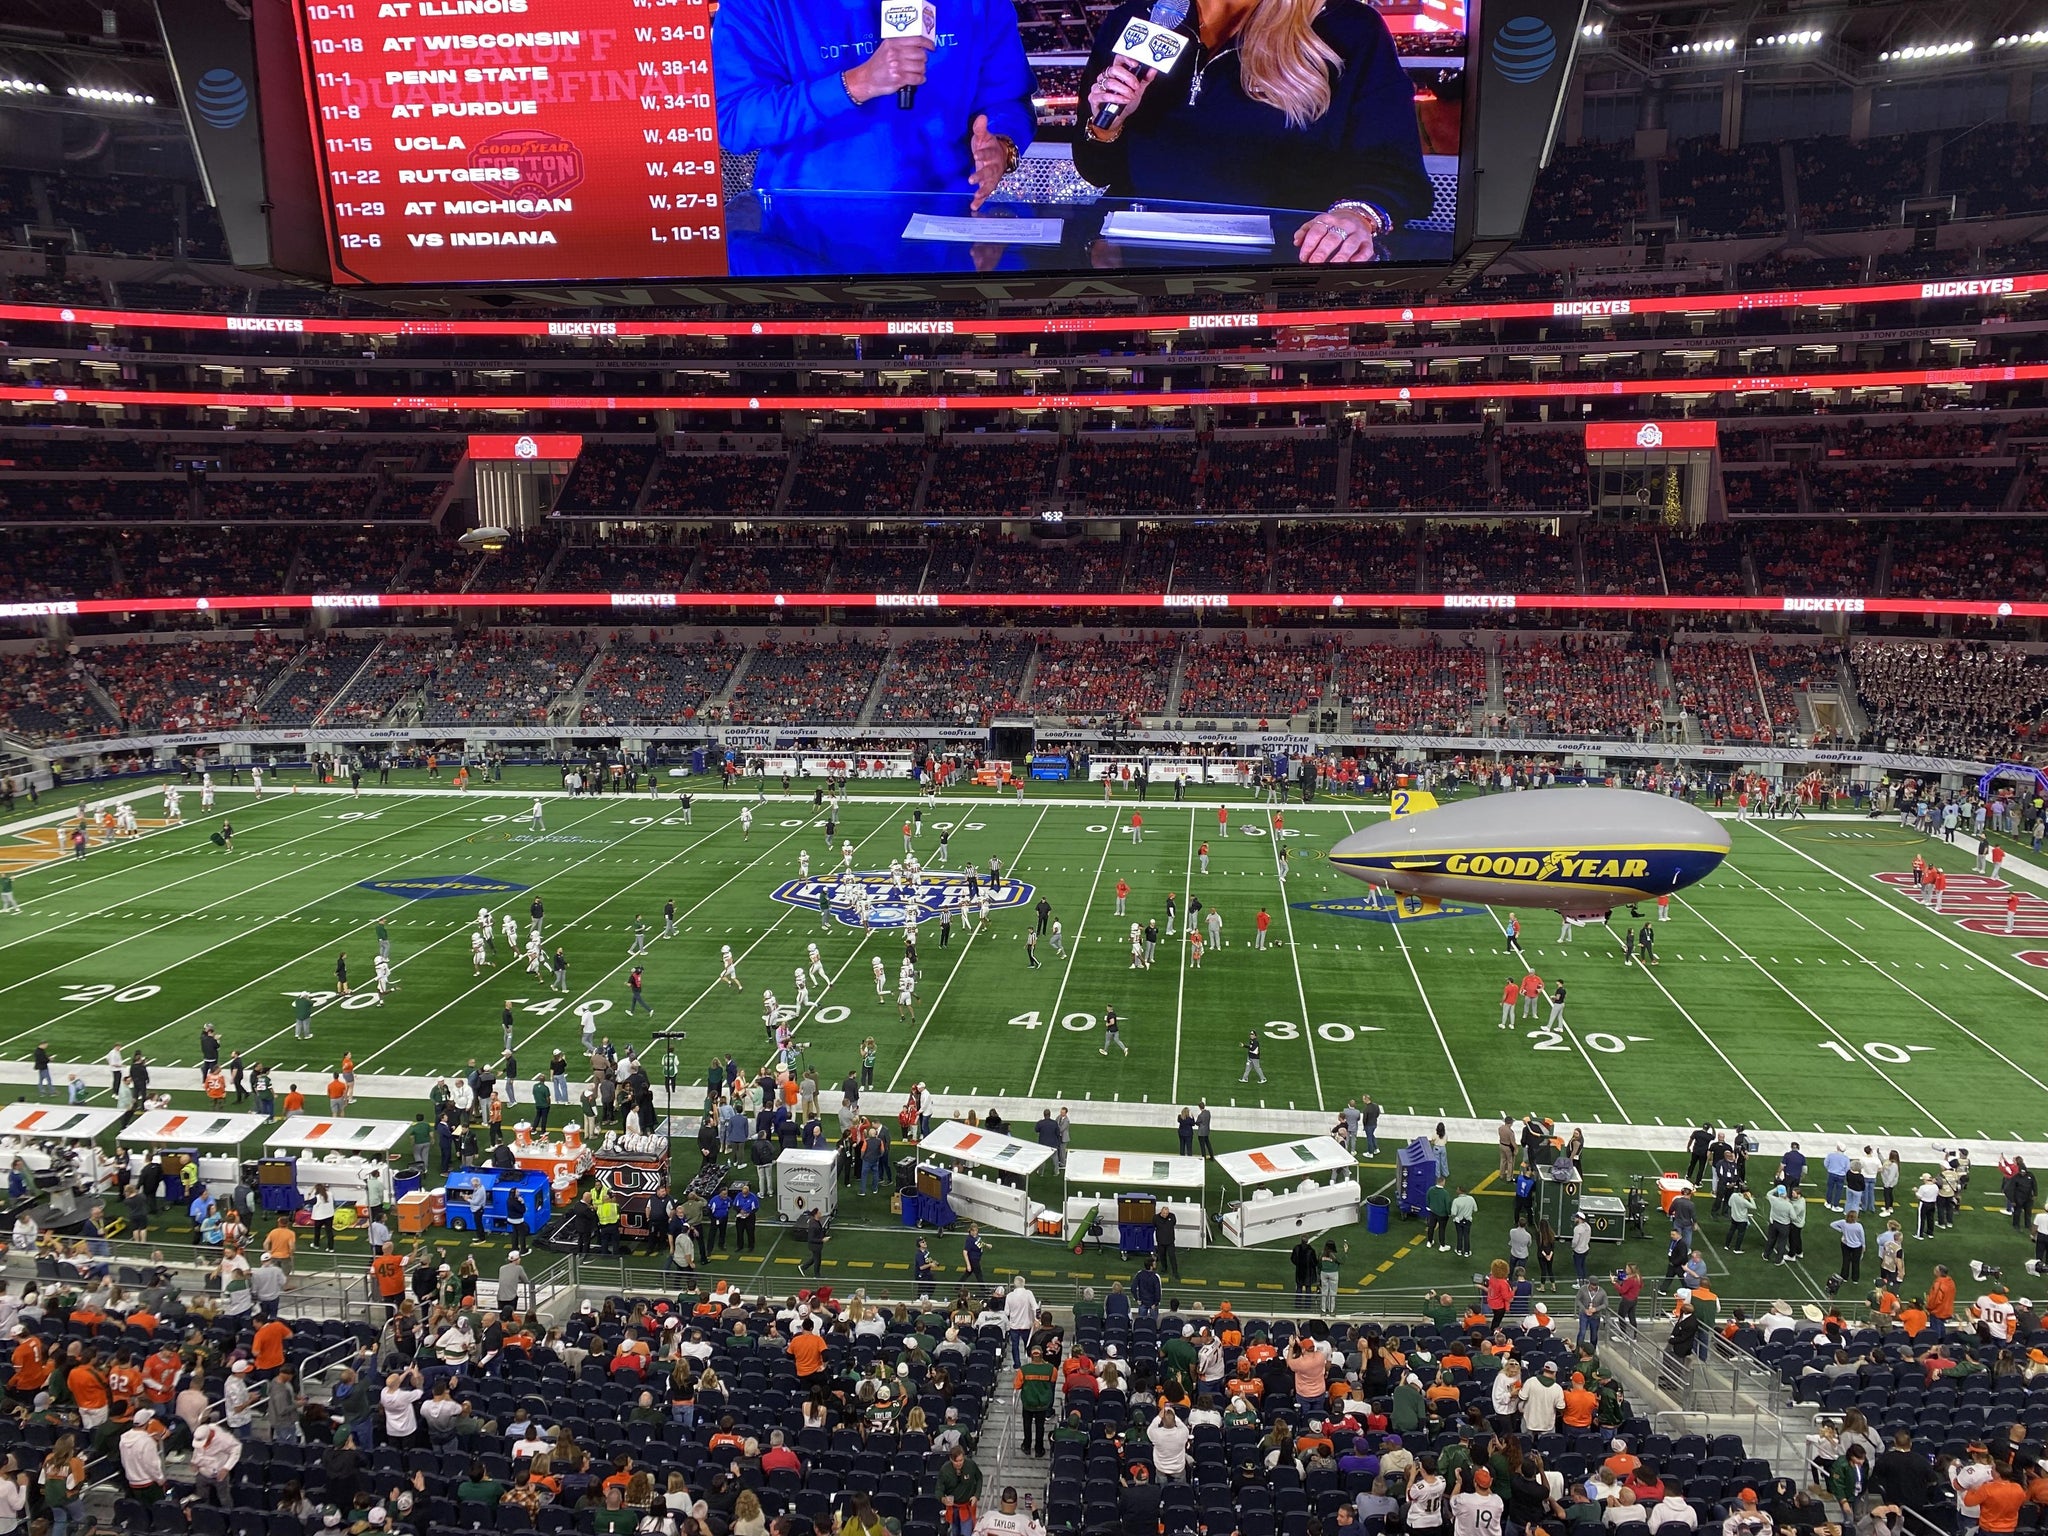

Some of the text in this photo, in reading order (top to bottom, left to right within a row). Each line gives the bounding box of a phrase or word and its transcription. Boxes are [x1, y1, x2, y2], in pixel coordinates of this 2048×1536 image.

[308, 4, 355, 20] 10-11
[378, 0, 529, 18] AT ILLINOIS
[383, 31, 580, 52] AT WISCONSIN
[635, 25, 706, 43] W, 34-0
[313, 38, 363, 54] 10-18
[385, 66, 549, 86] PENN STATE
[638, 60, 709, 78] W, 38-14
[317, 72, 351, 87] 11-1
[391, 100, 538, 119] AT PURDUE
[640, 93, 711, 111] W, 34-10
[322, 105, 361, 120] 11-8
[394, 135, 466, 151] UCLA
[643, 127, 713, 144] W, 48-10
[327, 138, 373, 153] 11-15
[398, 167, 521, 184] RUTGERS
[646, 160, 716, 177] W, 42-9
[331, 170, 381, 185] 11-22
[336, 202, 385, 217] 11-29
[403, 198, 573, 217] AT MICHIGAN
[649, 193, 718, 210] W, 27-9
[341, 233, 381, 249] 12-6
[407, 230, 558, 248] VS INDIANA
[651, 226, 721, 243] L, 10-13
[507, 274, 1258, 308] WINSTAR
[1921, 278, 2015, 298] BUCKEYES
[1553, 299, 1630, 316] BUCKEYES
[227, 317, 303, 333] BUCKEYES
[548, 322, 617, 335] BUCKEYES
[887, 321, 954, 335] BUCKEYES
[1189, 313, 1259, 329] BUCKEYES
[1873, 330, 1897, 339] TONY
[1899, 327, 1943, 337] DORSETT
[1685, 339, 1703, 347] TOM
[1705, 337, 1737, 346] LANDRY
[1033, 358, 1041, 366] 74
[1044, 358, 1058, 366] BOB
[1042, 511, 1063, 522] 45:32
[311, 593, 379, 608] BUCKEYES
[611, 593, 677, 606] BUCKEYES
[876, 593, 939, 607] BUCKEYES
[1163, 593, 1229, 607] BUCKEYES
[1444, 594, 1516, 609] BUCKEYES
[1784, 597, 1865, 613] BUCKEYES
[163, 734, 208, 744] GOODYEAR
[370, 730, 410, 738] GOODYEAR
[725, 727, 770, 735] GOODYEAR
[780, 728, 818, 736] GOODYEAR
[939, 728, 977, 736] GOODYEAR
[1198, 733, 1238, 741] GOODYEAR
[1261, 734, 1310, 743] GOODYEAR
[725, 736, 770, 746] COTTON
[1557, 742, 1602, 751] GOODYEAR
[1815, 752, 1863, 762] GOODYEAR
[1395, 793, 1410, 815] 2
[1446, 851, 1648, 880] GOODYEAR
[374, 881, 511, 892] GOODYEAR
[60, 984, 161, 1003] 20
[1007, 1010, 1098, 1032] 40
[1264, 1020, 1356, 1043] 30
[1526, 1030, 1627, 1054] 20
[1818, 1040, 1912, 1064] 10
[553, 1163, 569, 1178] G
[790, 1173, 817, 1182] ACC
[613, 1171, 641, 1189] U
[620, 1213, 643, 1230] U
[378, 1262, 396, 1278] 45
[1984, 1307, 2004, 1324] 10
[108, 1373, 129, 1393] 82
[993, 1518, 1017, 1531] TAYLOR
[1475, 1508, 1493, 1529] 19
